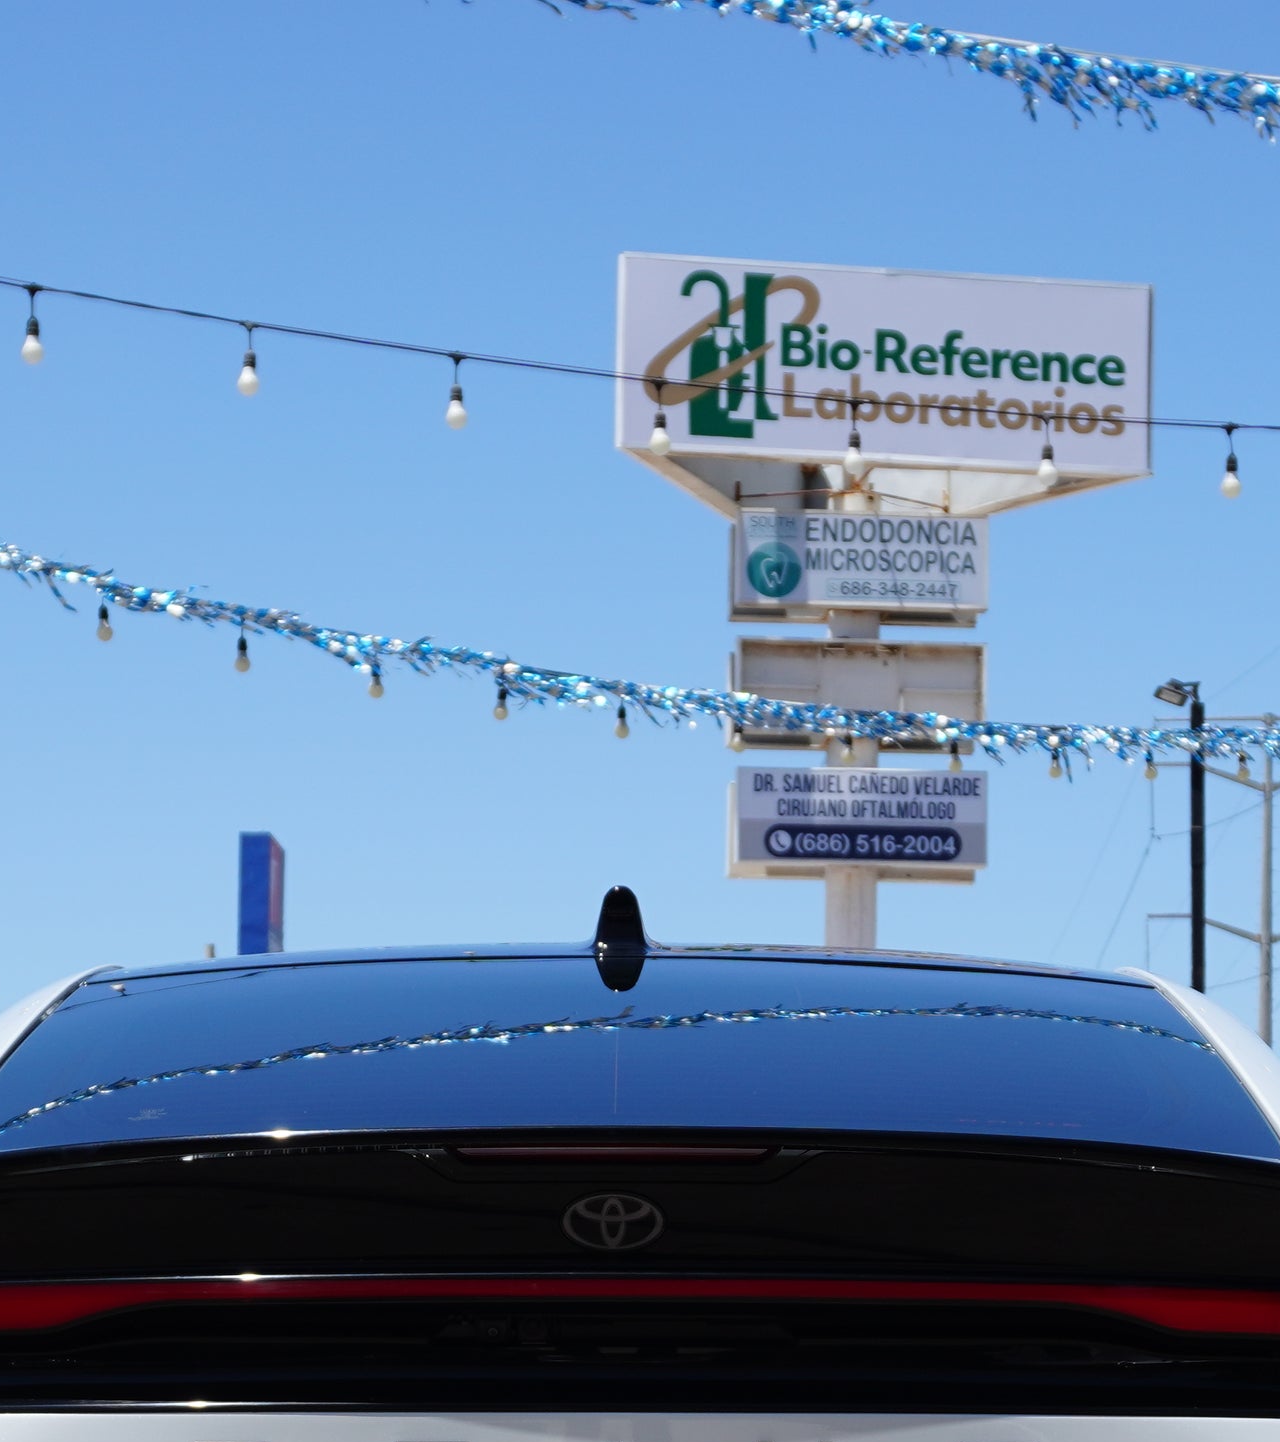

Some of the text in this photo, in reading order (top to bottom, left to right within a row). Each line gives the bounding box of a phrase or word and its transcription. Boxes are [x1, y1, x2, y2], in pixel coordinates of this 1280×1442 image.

[780, 322, 1126, 386] Bio-Reference
[783, 372, 1126, 436] Laboratorios
[805, 517, 977, 546] ENDODONCIA
[805, 548, 976, 575] MICROSCOPICA
[839, 580, 959, 598] 686-348-2447
[753, 773, 982, 796] DR. SAMUEL CAÑEDO VELARDE
[777, 798, 957, 820] CIRUJANO OFTALMÓLOGO
[794, 831, 957, 855] (686) 516-2004
